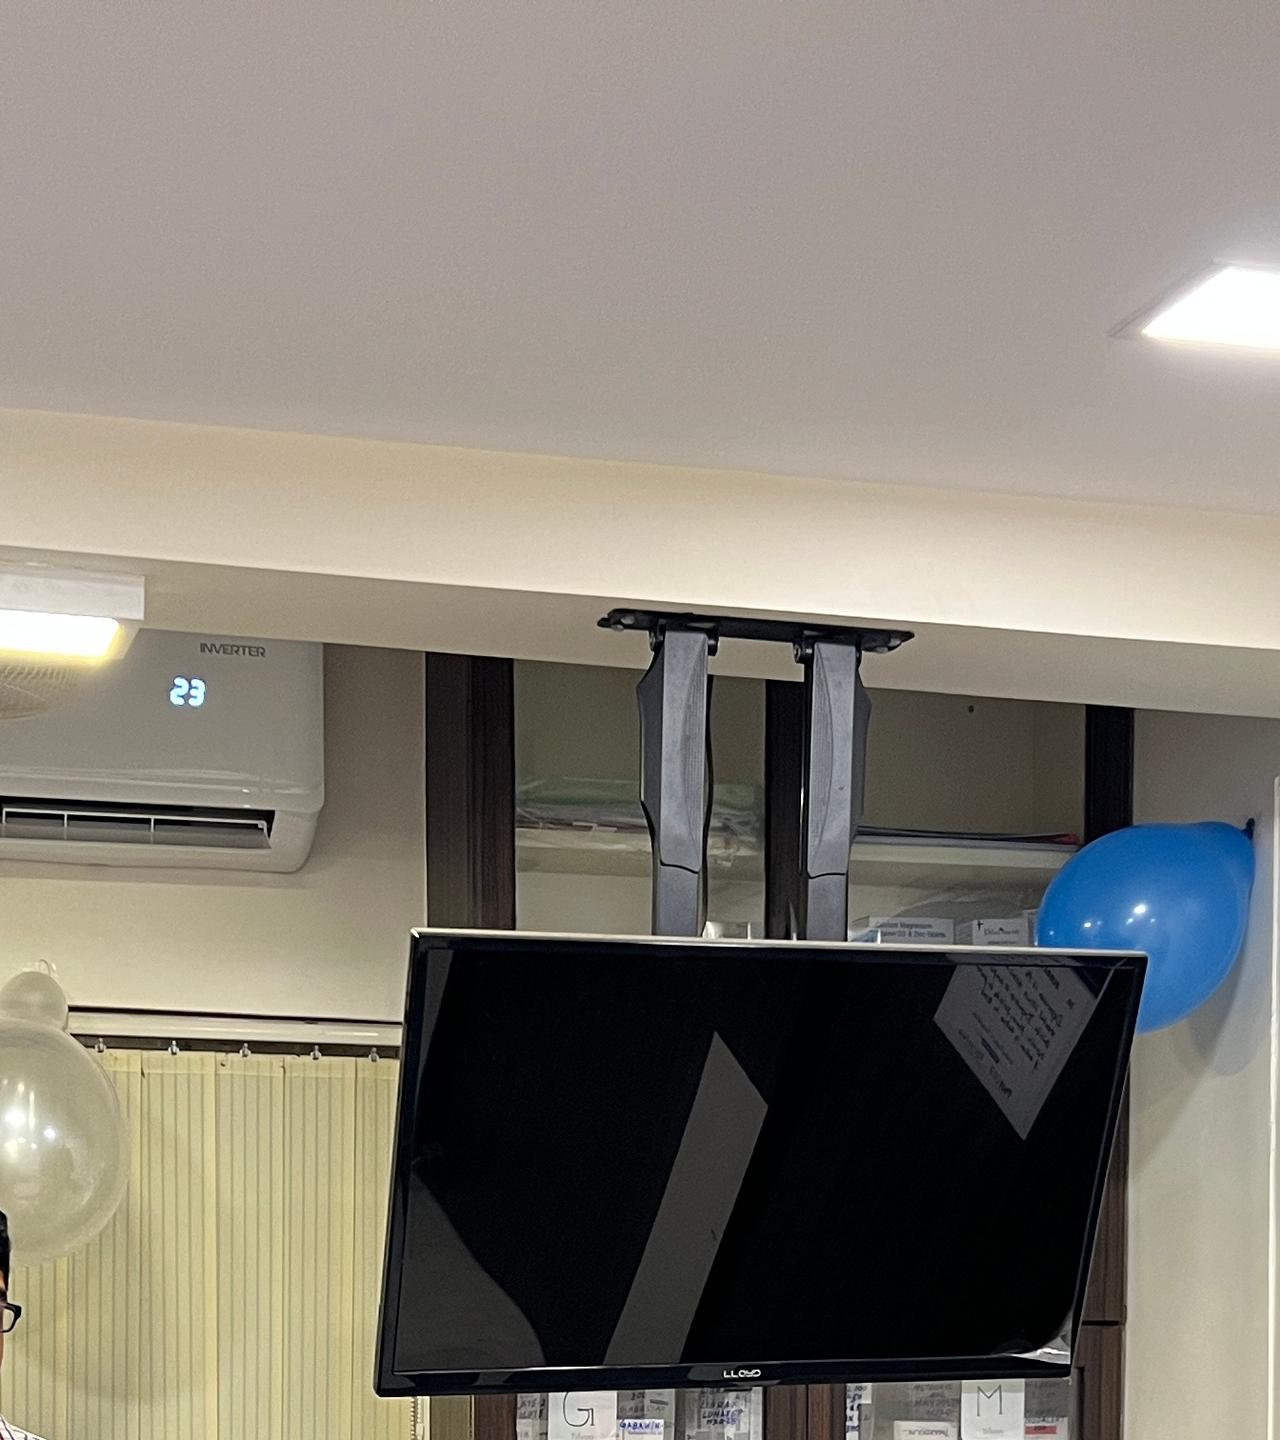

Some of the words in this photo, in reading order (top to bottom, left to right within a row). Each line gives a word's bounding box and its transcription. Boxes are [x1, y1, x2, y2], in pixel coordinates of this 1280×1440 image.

[199, 642, 267, 658] INVERTER
[169, 676, 206, 707] 23
[723, 1368, 762, 1379] LLOYD
[563, 1391, 596, 1428] G
[977, 1384, 1003, 1417] M
